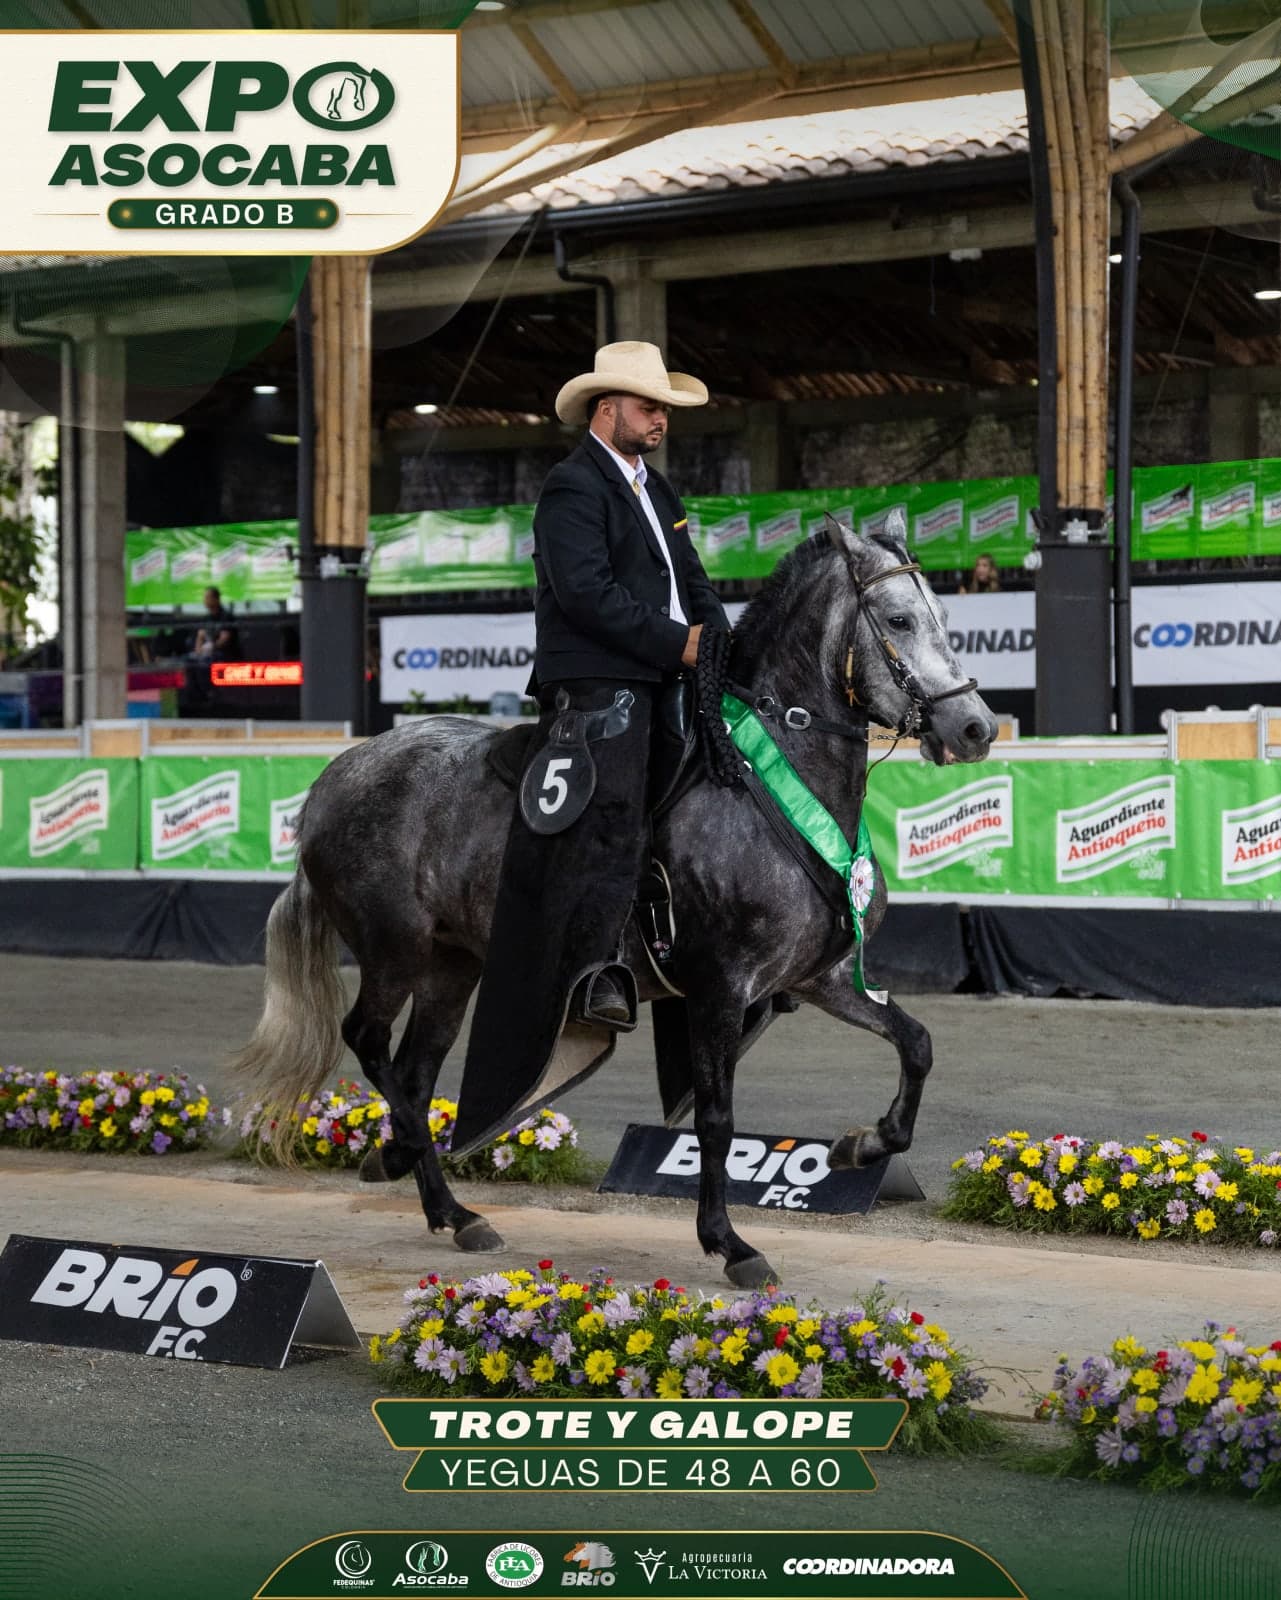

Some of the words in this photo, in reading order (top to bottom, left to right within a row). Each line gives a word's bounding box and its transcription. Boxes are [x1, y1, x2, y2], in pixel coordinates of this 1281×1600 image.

[393, 646, 536, 670] COORDINAD
[538, 758, 573, 815] 5
[908, 797, 1001, 841] Aguardiente
[908, 812, 1003, 860] Antioqueño
[1067, 812, 1167, 862] Antioqueño
[1069, 797, 1166, 843] Aguardiente
[1236, 818, 1281, 845] Agua
[757, 1185, 812, 1209] F.C.
[145, 1325, 207, 1361] F.C.
